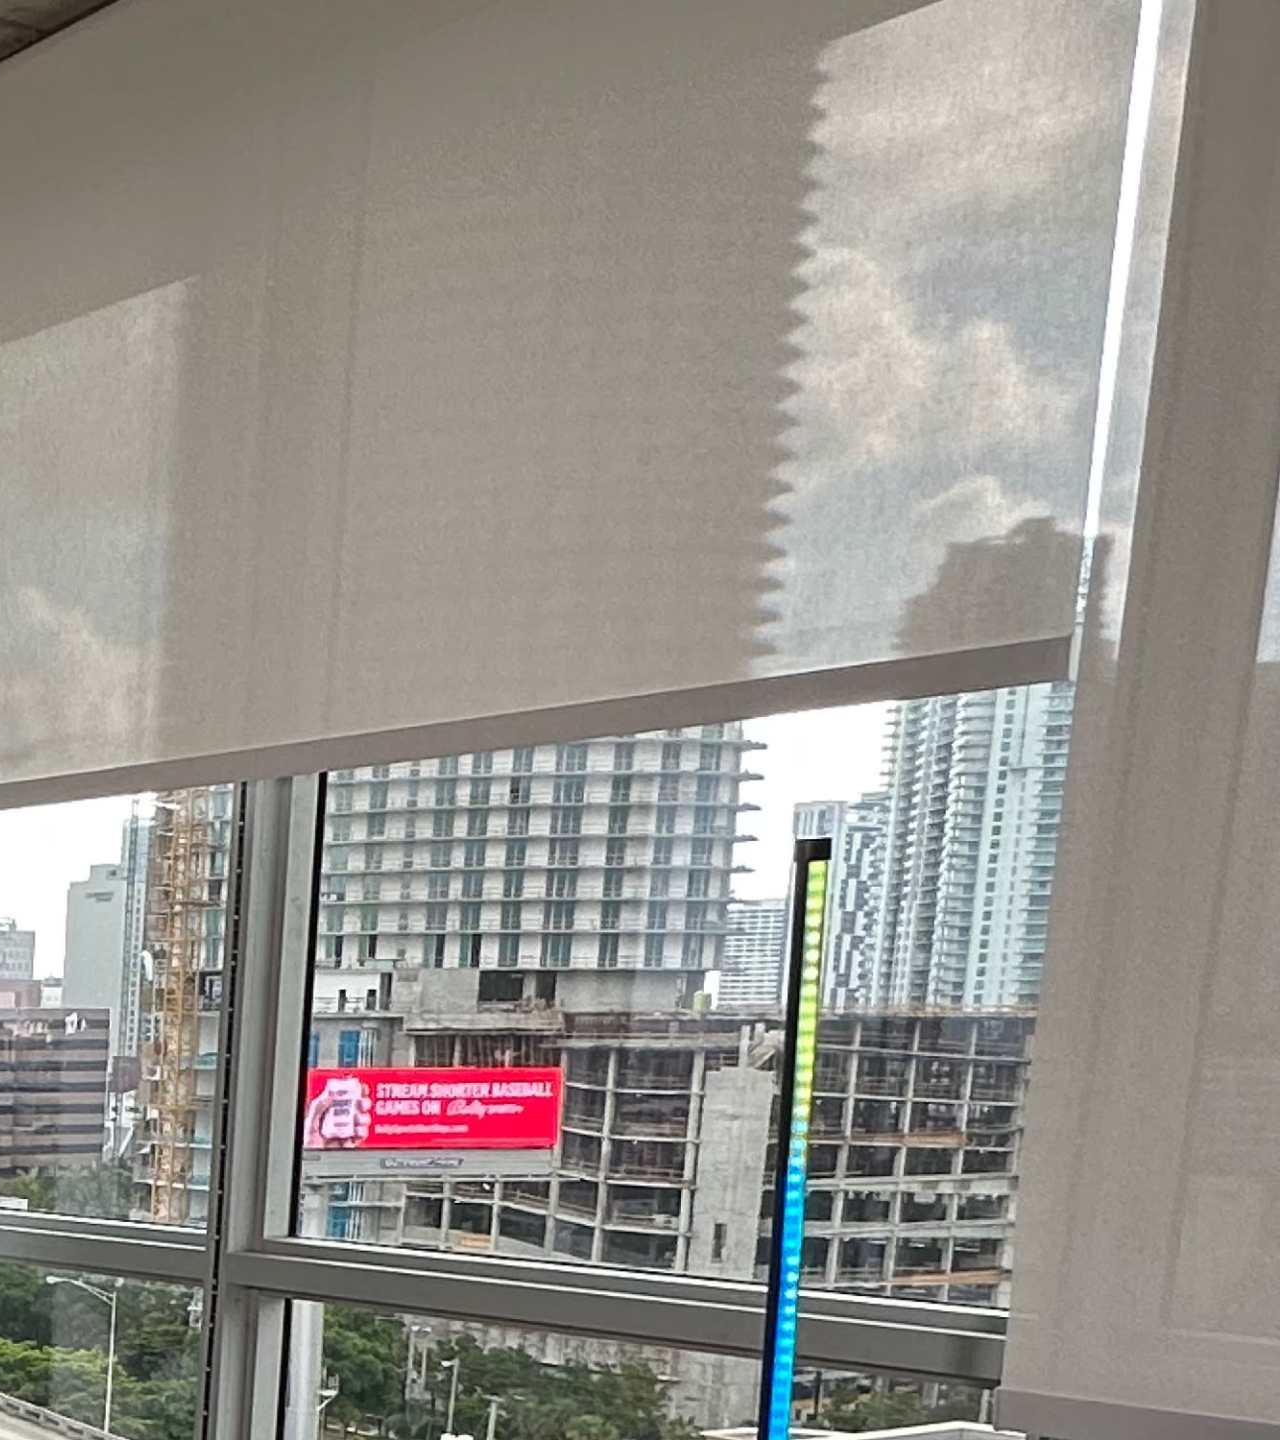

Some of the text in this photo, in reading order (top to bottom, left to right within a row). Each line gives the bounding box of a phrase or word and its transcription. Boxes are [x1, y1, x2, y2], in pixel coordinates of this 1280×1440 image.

[376, 1082, 553, 1098] STREAM SHORTER BASEBALL
[375, 1100, 420, 1116] GAMES
[421, 1100, 441, 1115] ON
